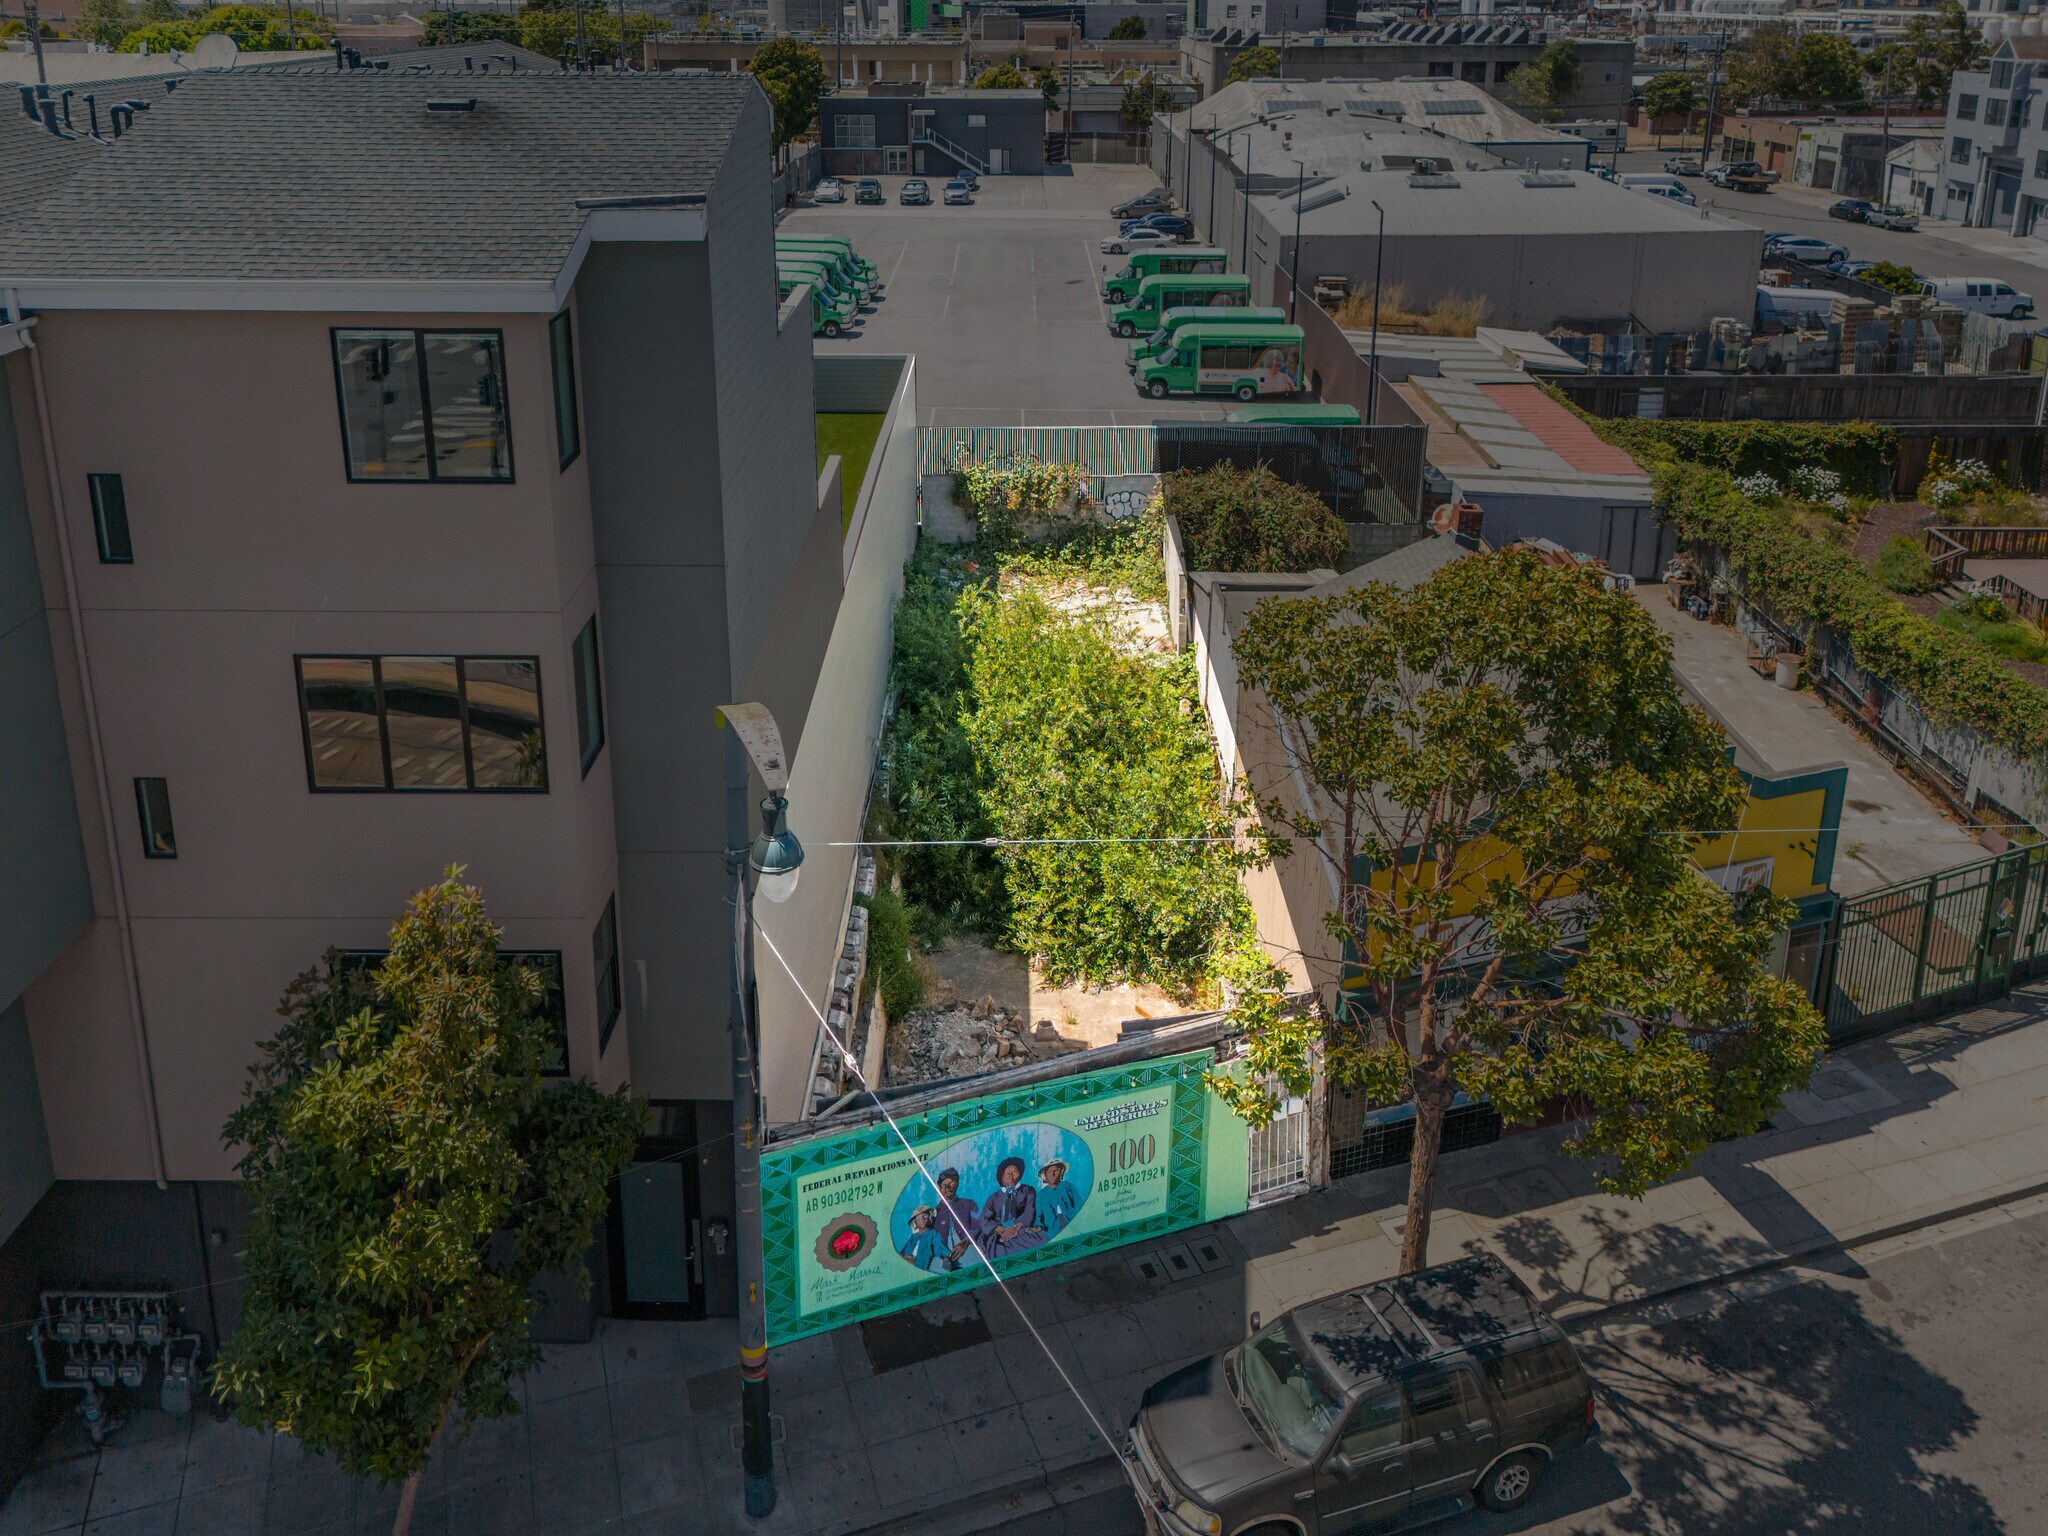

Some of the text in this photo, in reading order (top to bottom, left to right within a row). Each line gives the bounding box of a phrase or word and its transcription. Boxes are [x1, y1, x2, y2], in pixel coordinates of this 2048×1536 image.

[1074, 1107, 1119, 1127] UNITED
[1119, 1099, 1169, 1117] STATES
[1084, 1109, 1159, 1132] OF AMERICA
[1108, 1133, 1156, 1174] 100
[802, 1175, 843, 1193] FEDERAL
[844, 1159, 907, 1181] REPARATIONS
